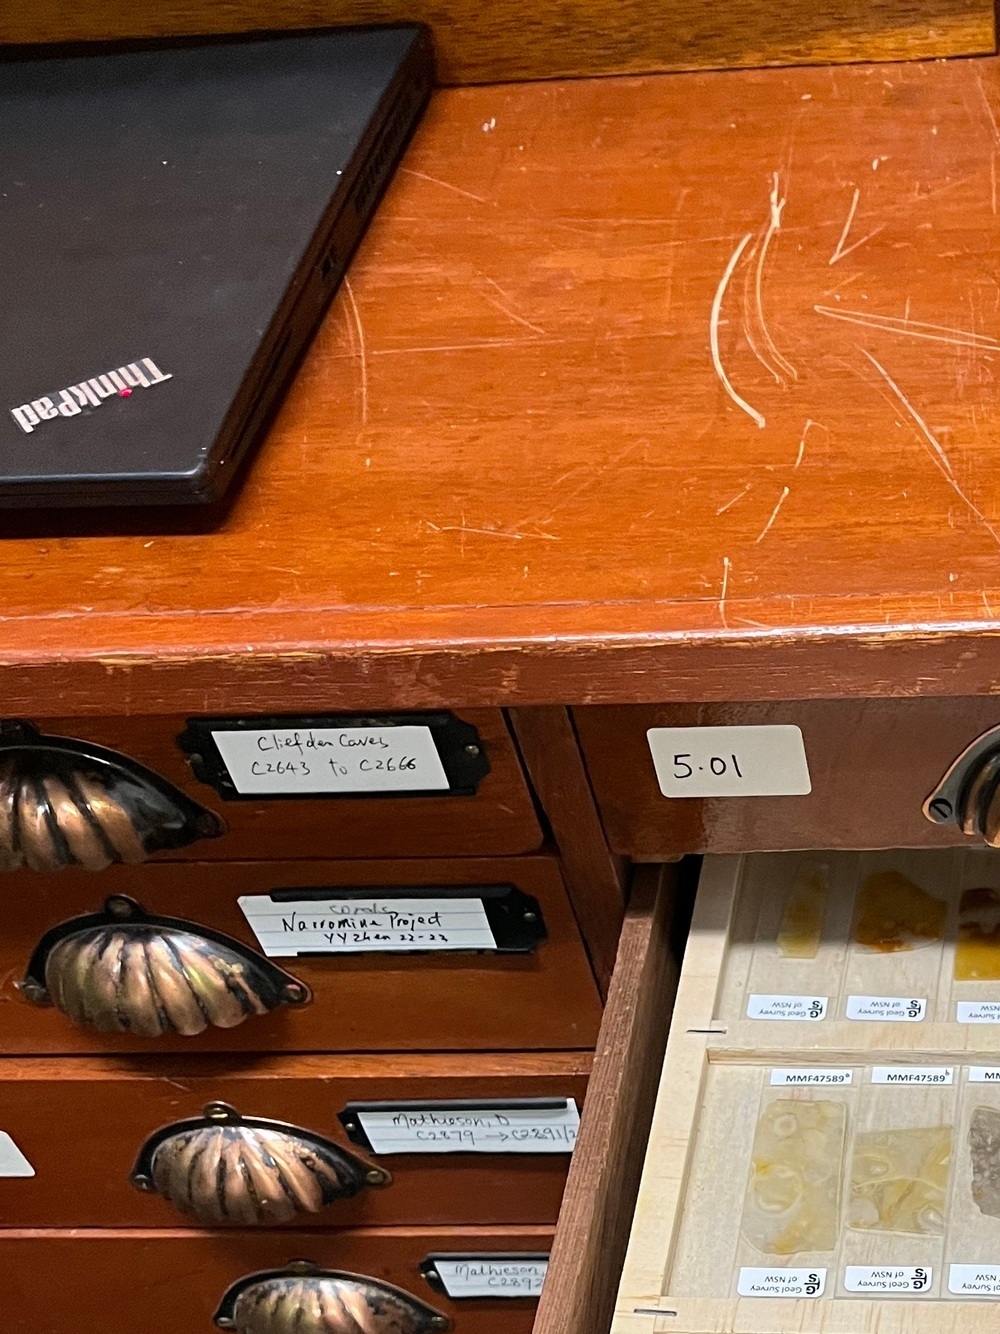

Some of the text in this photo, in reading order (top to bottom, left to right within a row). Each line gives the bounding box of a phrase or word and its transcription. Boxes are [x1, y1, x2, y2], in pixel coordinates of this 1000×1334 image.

[11, 357, 173, 434] ThinkPad
[339, 733, 389, 749] Caves
[251, 757, 417, 777] C2643 to C2666
[389, 911, 443, 931] Project
[764, 1276, 798, 1284] of NSW
[871, 1271, 905, 1279] of NSW
[975, 1274, 997, 1282] NSW
[750, 1284, 803, 1294] Geol Survey
[857, 1280, 910, 1289] Geol Survey
[961, 1283, 992, 1293] Survey
